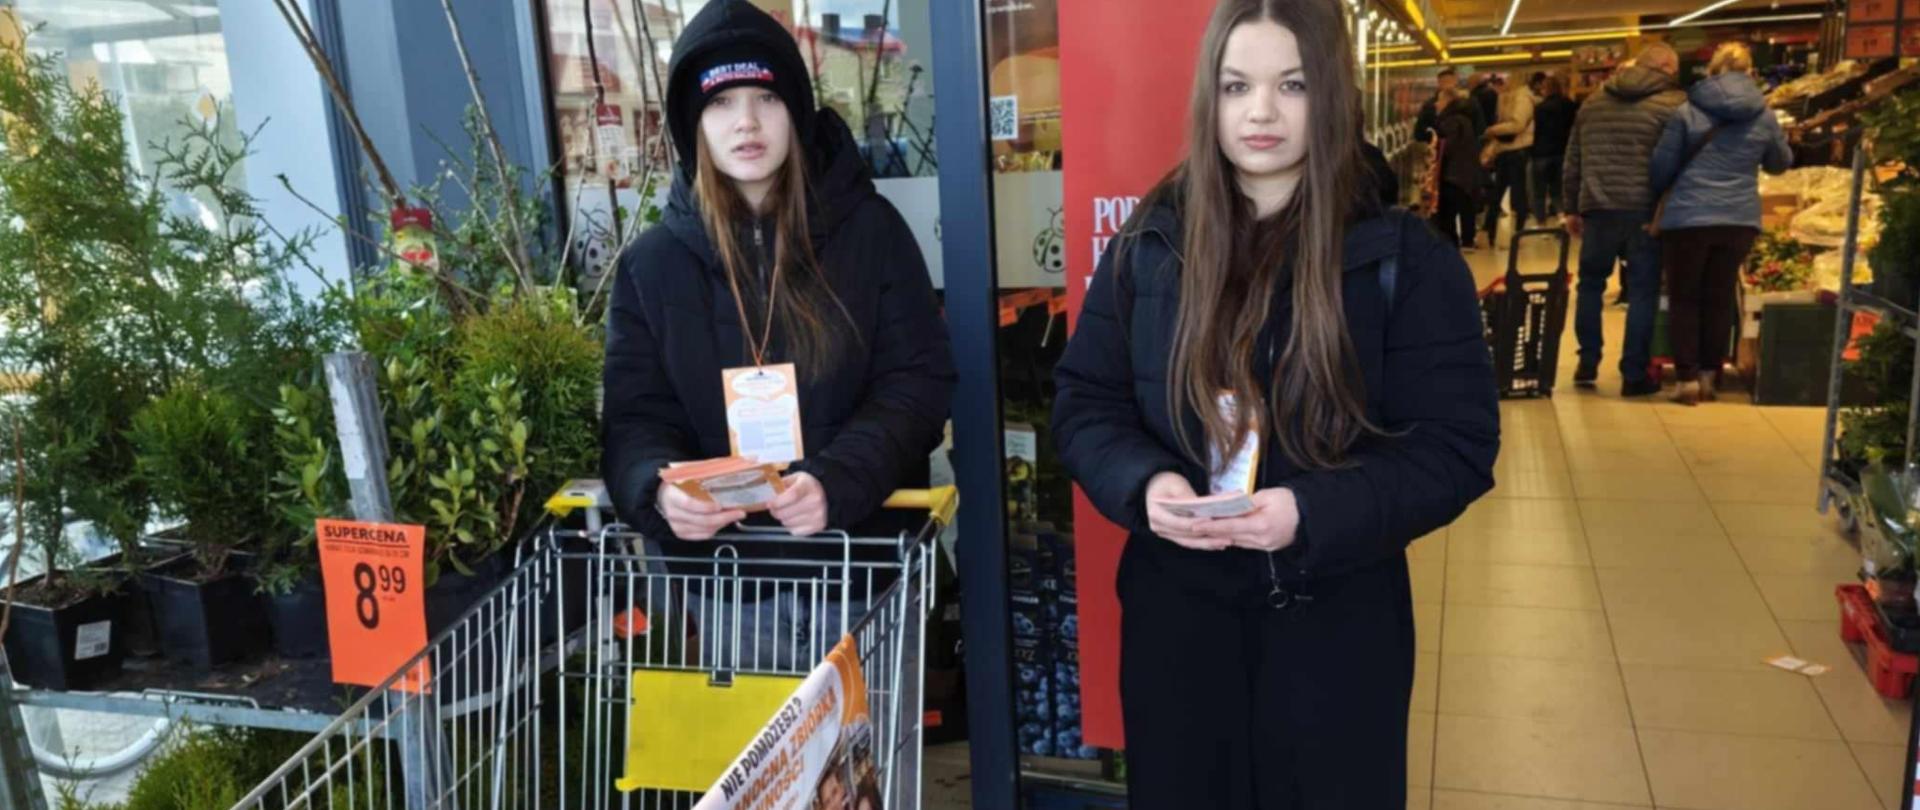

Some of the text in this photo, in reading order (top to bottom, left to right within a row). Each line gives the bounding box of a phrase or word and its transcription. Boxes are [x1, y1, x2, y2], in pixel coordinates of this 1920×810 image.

[323, 525, 407, 543] SUPERCENA
[353, 562, 407, 630] 8 99
[720, 766, 745, 802] NIE
